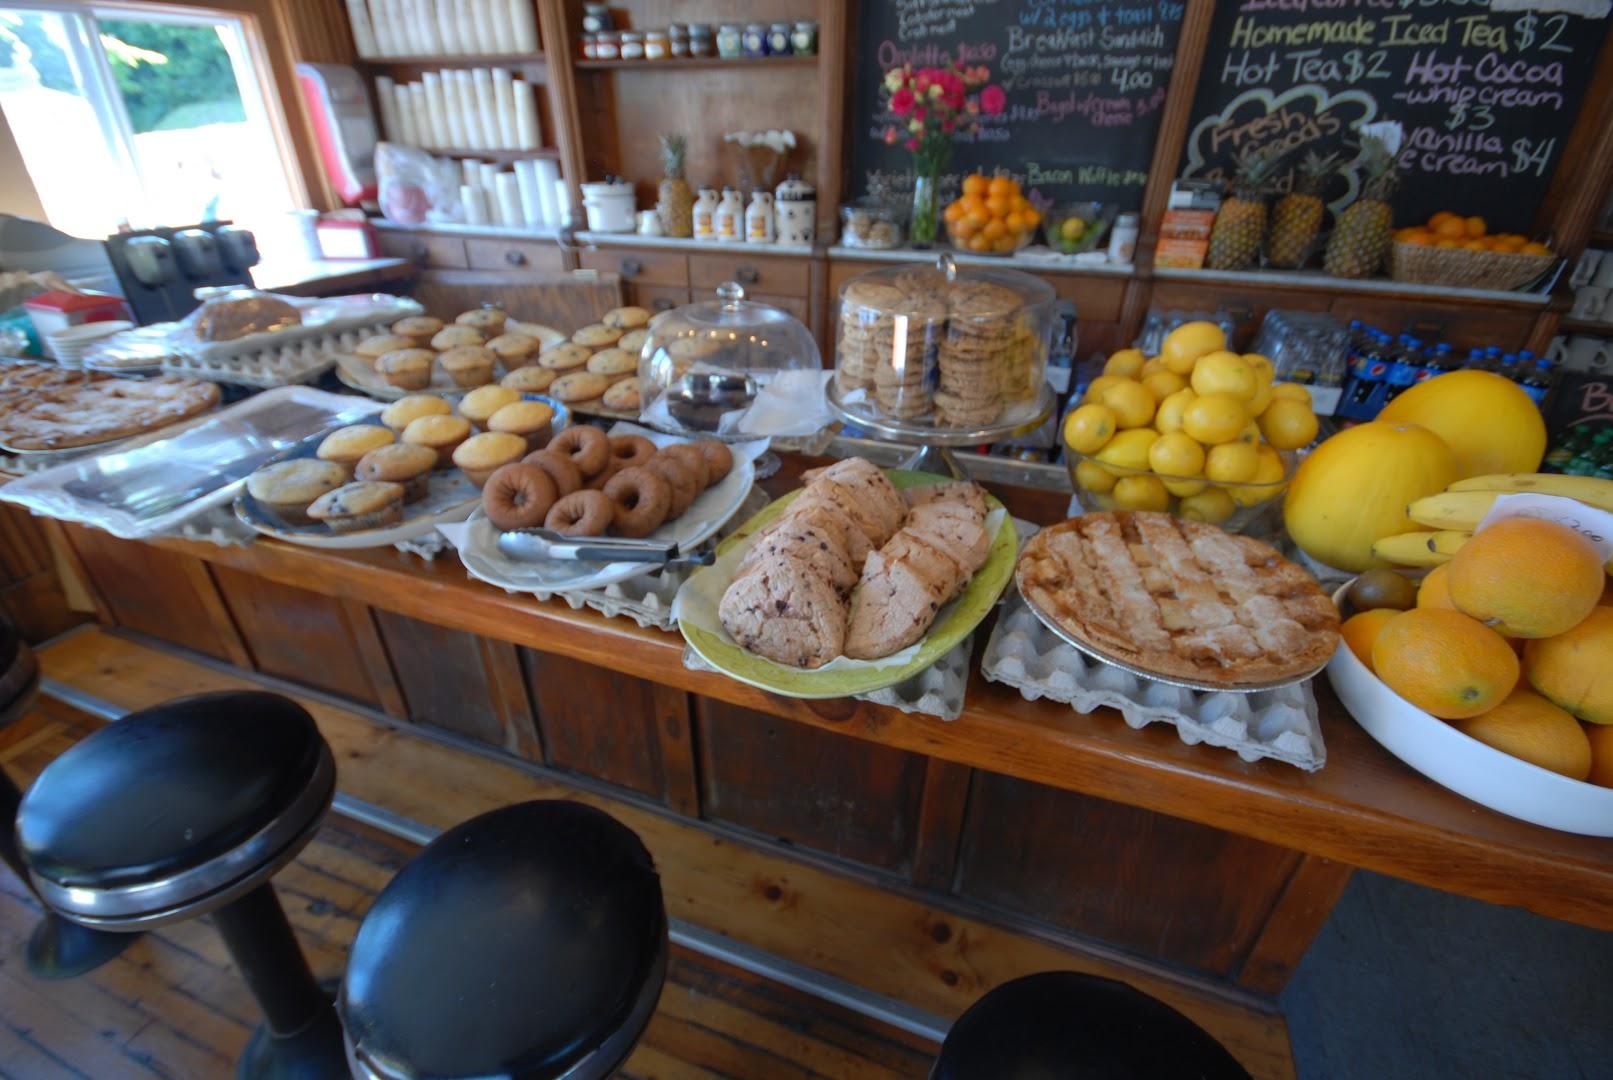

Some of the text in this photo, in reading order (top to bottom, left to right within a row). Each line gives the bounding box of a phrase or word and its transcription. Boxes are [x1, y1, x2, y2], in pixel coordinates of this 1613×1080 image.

[1004, 23, 1165, 53] Breakfast Sandwich
[1229, 14, 1377, 48] Homemade
[1378, 13, 1450, 47] Iced
[1454, 14, 1509, 53] Tea
[1220, 48, 1393, 87] Hot Tea $2
[1404, 49, 1564, 87] Hot Cocoa
[1444, 102, 1496, 131] $3
[1478, 85, 1564, 111] cream
[1211, 106, 1306, 154] Fresh
[1420, 151, 1508, 178] cream
[1511, 137, 1557, 177] $4
